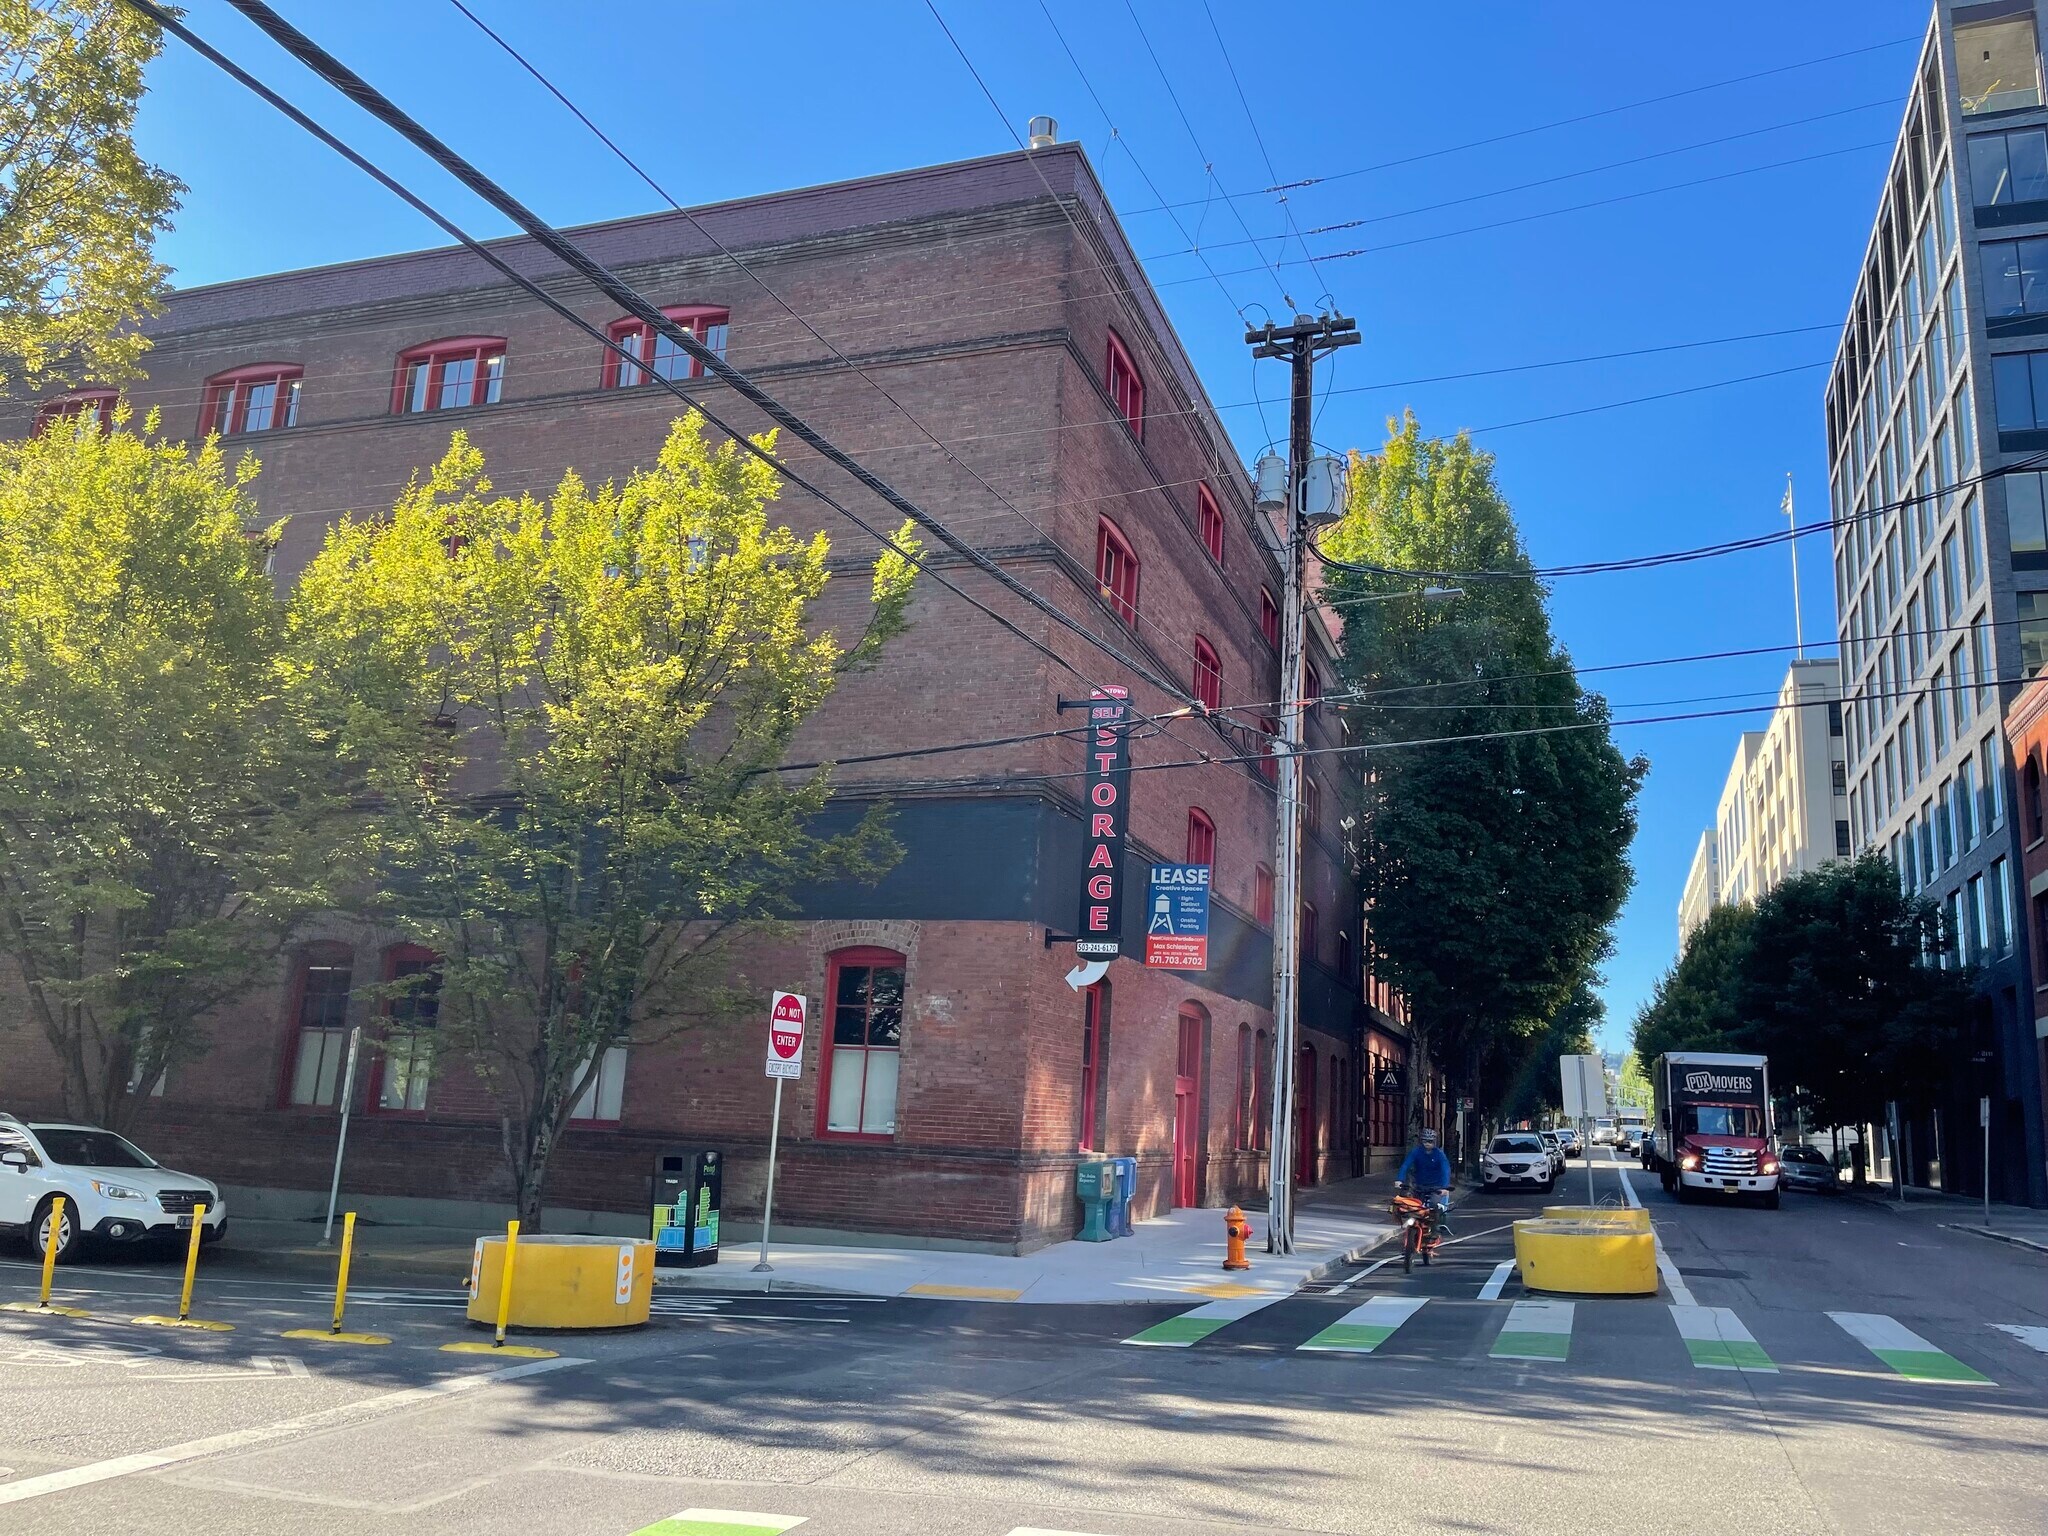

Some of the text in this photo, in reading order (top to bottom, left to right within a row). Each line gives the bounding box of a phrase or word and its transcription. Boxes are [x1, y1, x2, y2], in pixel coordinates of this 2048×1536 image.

[1091, 687, 1126, 696] DONTOWN
[1092, 706, 1124, 719] SELF
[1088, 724, 1118, 931] STORAGE
[1151, 868, 1208, 884] LEASE
[1078, 943, 1117, 951] 503-241-6170
[1150, 956, 1202, 965] 971.703.4702
[778, 1006, 800, 1018] DO NOT
[777, 1035, 796, 1047] ENTER
[1690, 1075, 1752, 1089] PDX MOVERS
